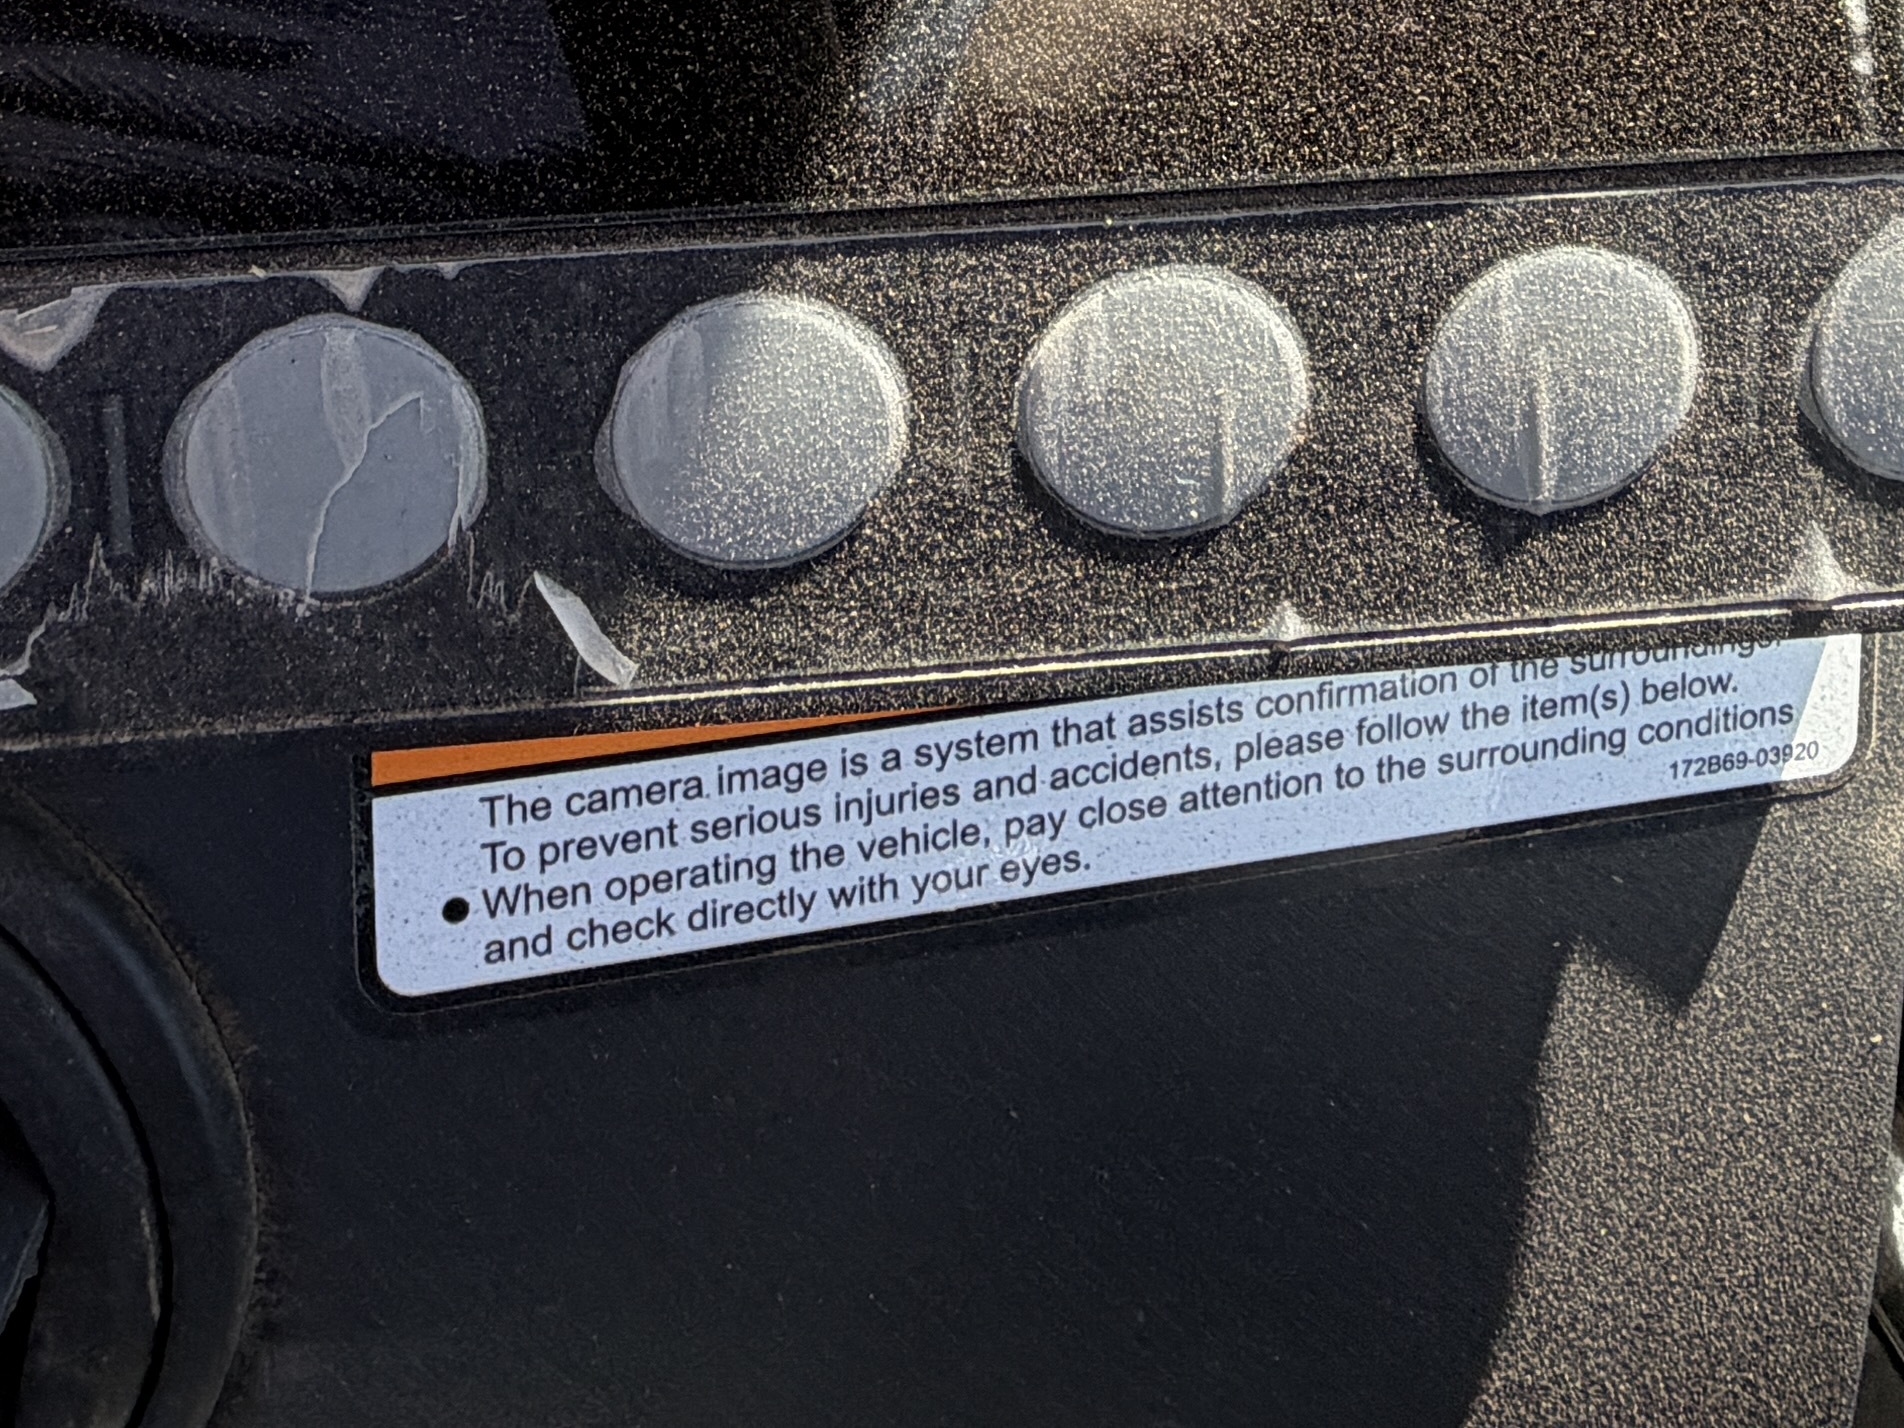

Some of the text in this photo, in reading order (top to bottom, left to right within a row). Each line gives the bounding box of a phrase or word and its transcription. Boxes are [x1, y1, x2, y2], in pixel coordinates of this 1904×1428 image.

[479, 794, 552, 828] The
[566, 776, 703, 817] camera
[717, 758, 827, 795] image
[841, 748, 868, 777] is
[881, 748, 901, 771] a
[914, 728, 1039, 772] system
[1051, 712, 1117, 746] that
[1127, 697, 1244, 735] assists
[1255, 668, 1458, 718] confirmation
[481, 671, 1738, 875] To prevent serious injuries and accidents, please follow the item(s) below.
[481, 702, 1795, 921] When operating the vehicle, pay close attention to the surrounding conditions
[1668, 741, 1821, 780] 172B69-03920
[484, 849, 1092, 965] and check directly with your eyes.
